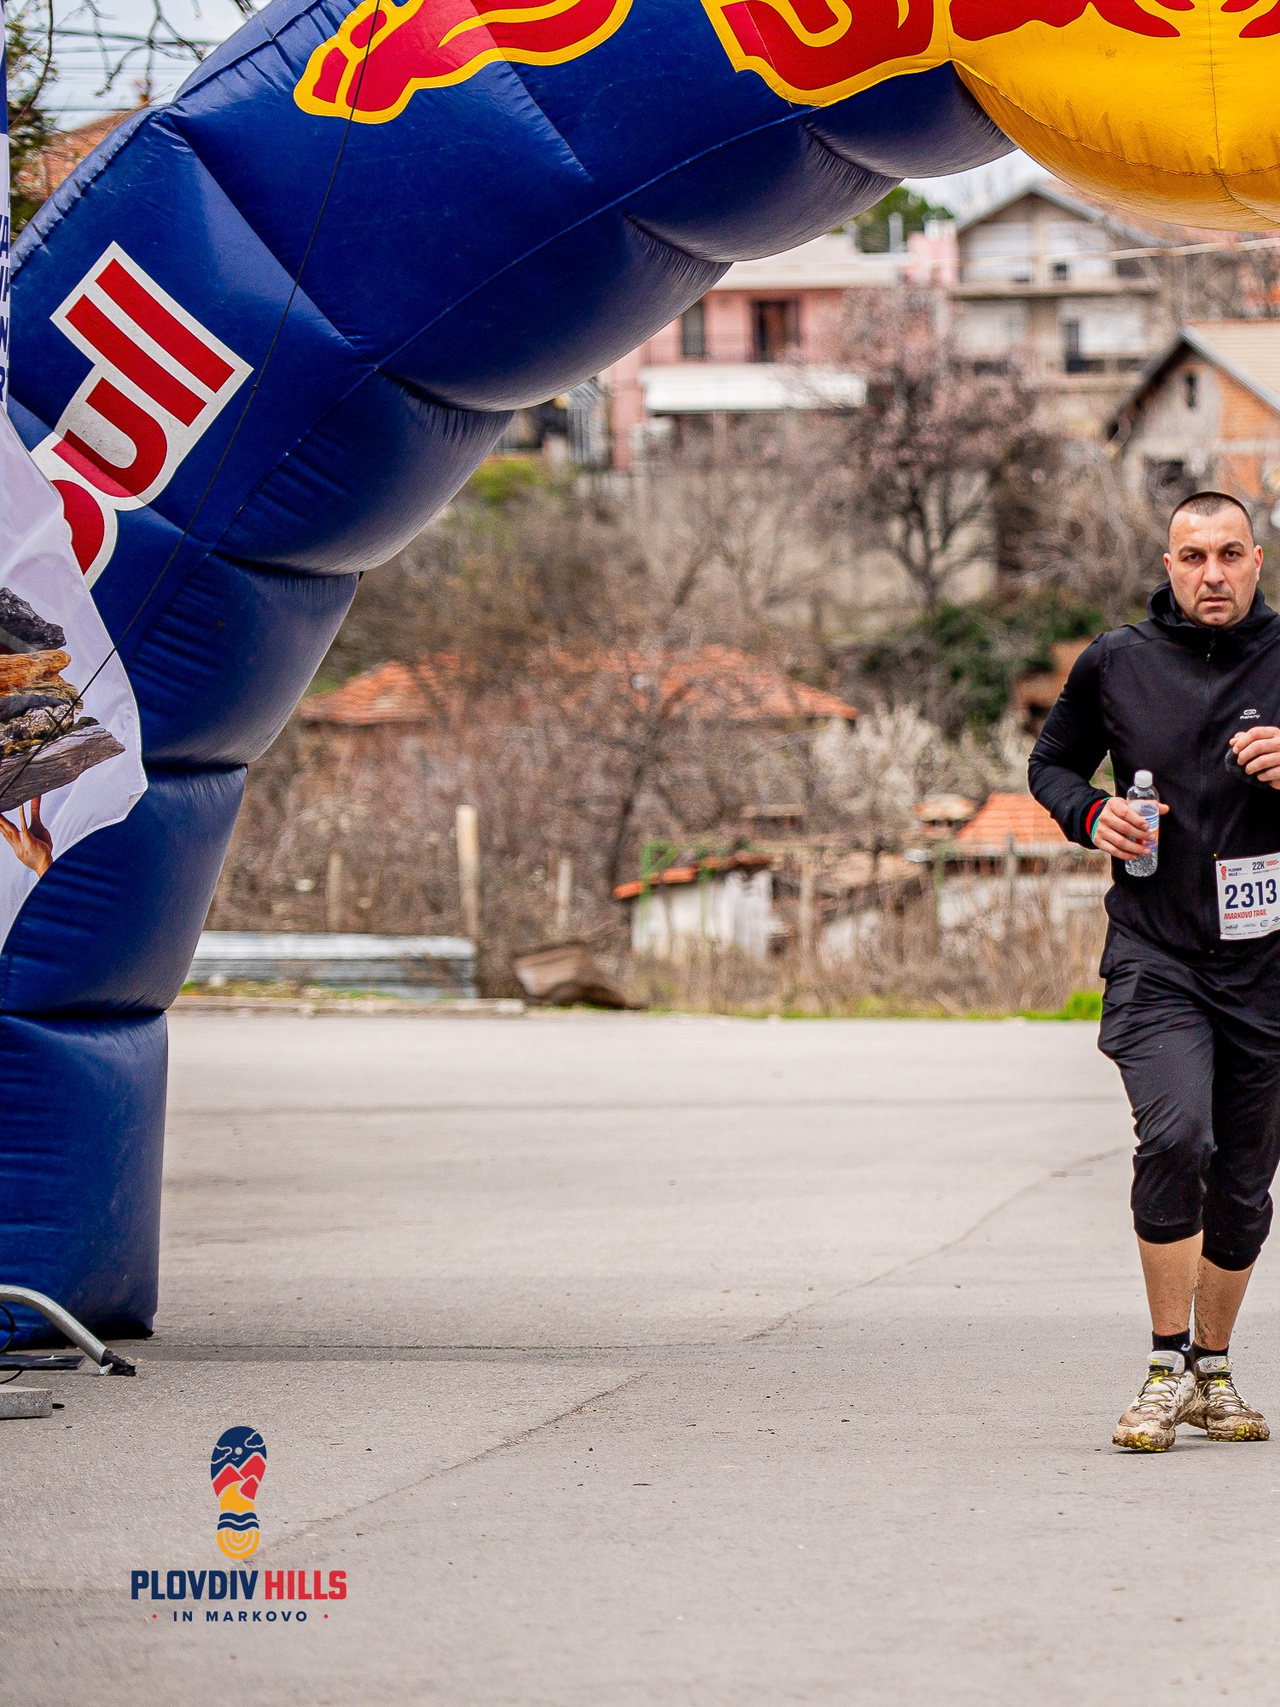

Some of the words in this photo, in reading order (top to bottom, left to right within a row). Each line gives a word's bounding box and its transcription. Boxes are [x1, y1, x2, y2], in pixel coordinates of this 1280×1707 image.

[1224, 878, 1278, 909] 2313
[1223, 910, 1253, 920] MARKOVO
[1253, 909, 1267, 917] TRAIL
